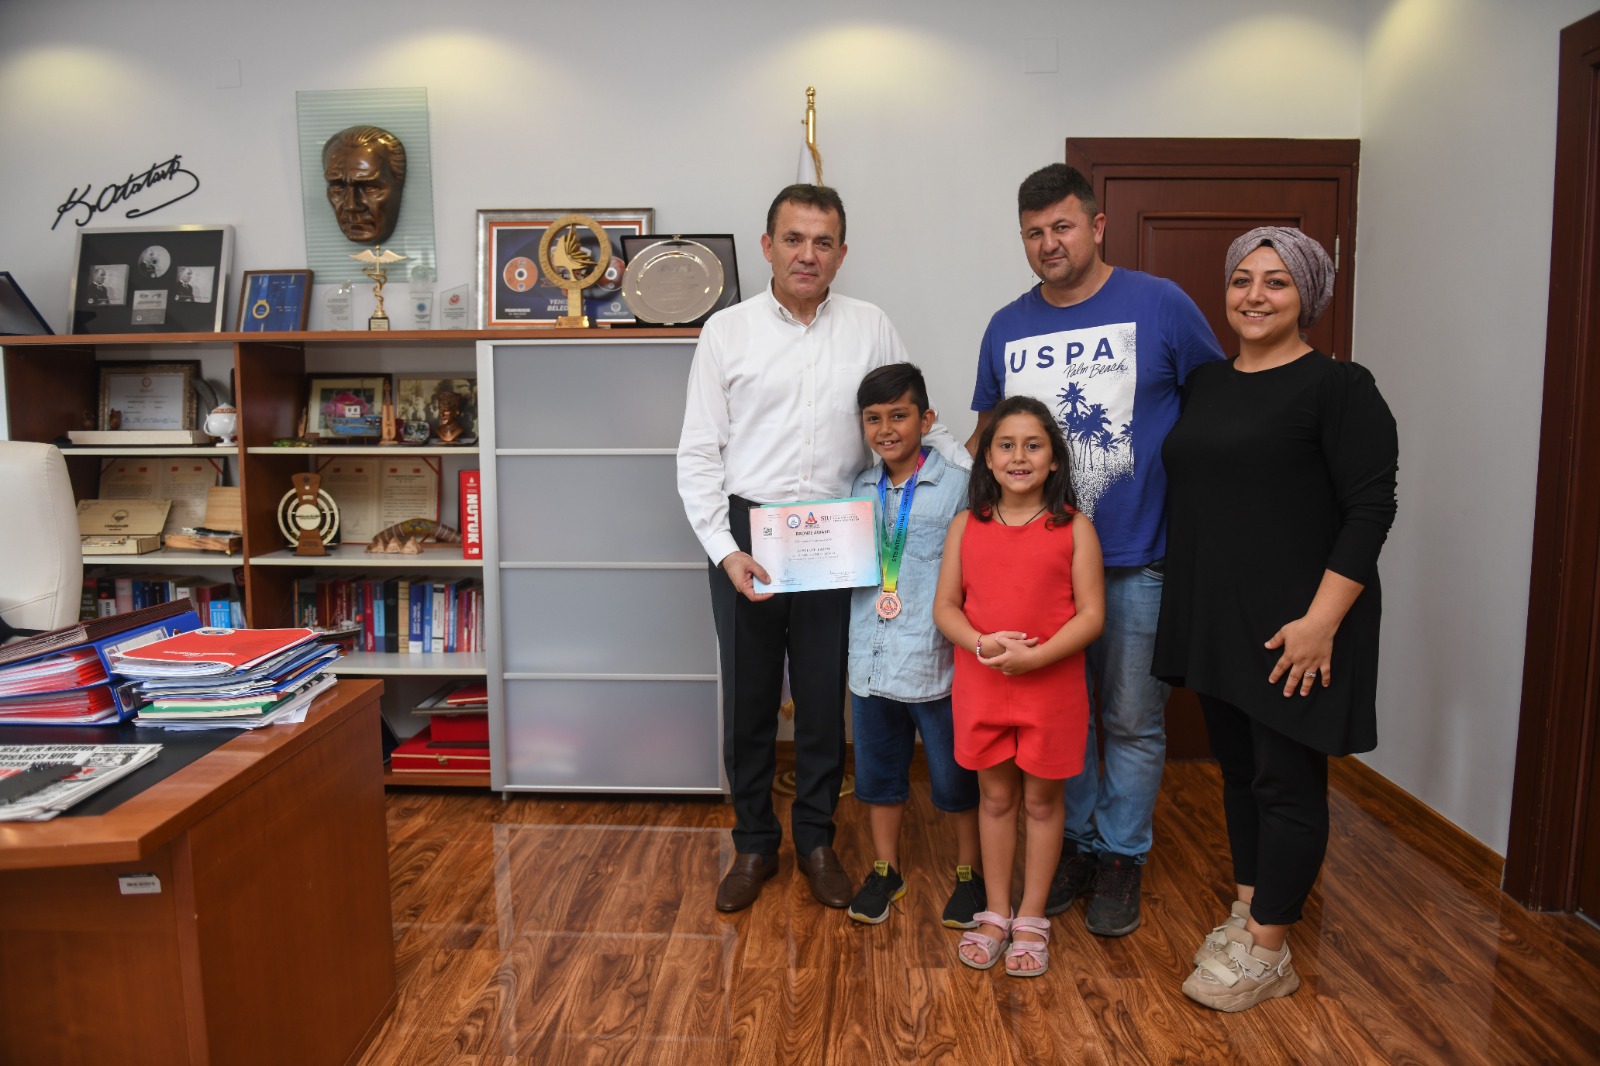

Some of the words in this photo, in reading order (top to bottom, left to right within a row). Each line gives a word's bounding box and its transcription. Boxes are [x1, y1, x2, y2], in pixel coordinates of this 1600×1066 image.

[1010, 337, 1115, 373] USPA
[1063, 362, 1088, 378] Palm
[1088, 357, 1129, 379] Beach
[466, 493, 480, 544] NUTUK
